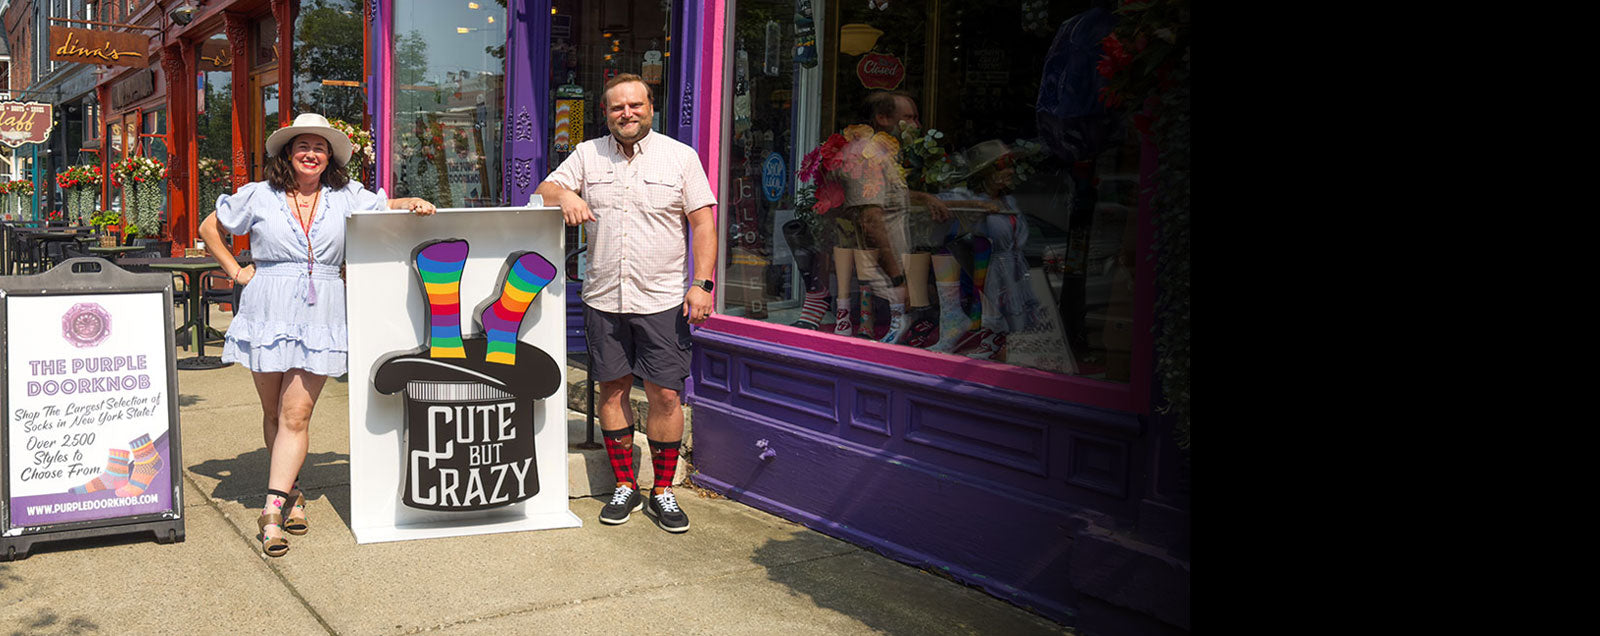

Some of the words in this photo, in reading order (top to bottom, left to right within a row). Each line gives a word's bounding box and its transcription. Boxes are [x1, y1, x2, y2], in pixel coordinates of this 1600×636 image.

[56, 32, 142, 60] dina's
[864, 60, 899, 76] Closed
[29, 359, 67, 376] THE
[72, 355, 147, 374] PURPLE
[27, 374, 151, 397] DOORKNOB
[14, 408, 40, 421] Shop
[42, 405, 60, 418] The
[65, 399, 106, 416] Largest
[106, 396, 148, 410] Selection
[151, 392, 161, 405] of
[23, 420, 53, 433] Socks
[57, 419, 66, 428] in
[69, 415, 95, 429] New
[97, 407, 124, 426] York
[126, 405, 156, 419] State!
[428, 402, 516, 459] CUTE
[26, 436, 57, 451] Over
[61, 432, 96, 448] 2500
[33, 450, 69, 469] Styles
[73, 450, 83, 462] to
[469, 443, 504, 466] BUT
[20, 467, 63, 482] Choose
[411, 450, 533, 507] CRAZY
[27, 494, 158, 516] WWW.PURPLEDOORKNOB.COM
